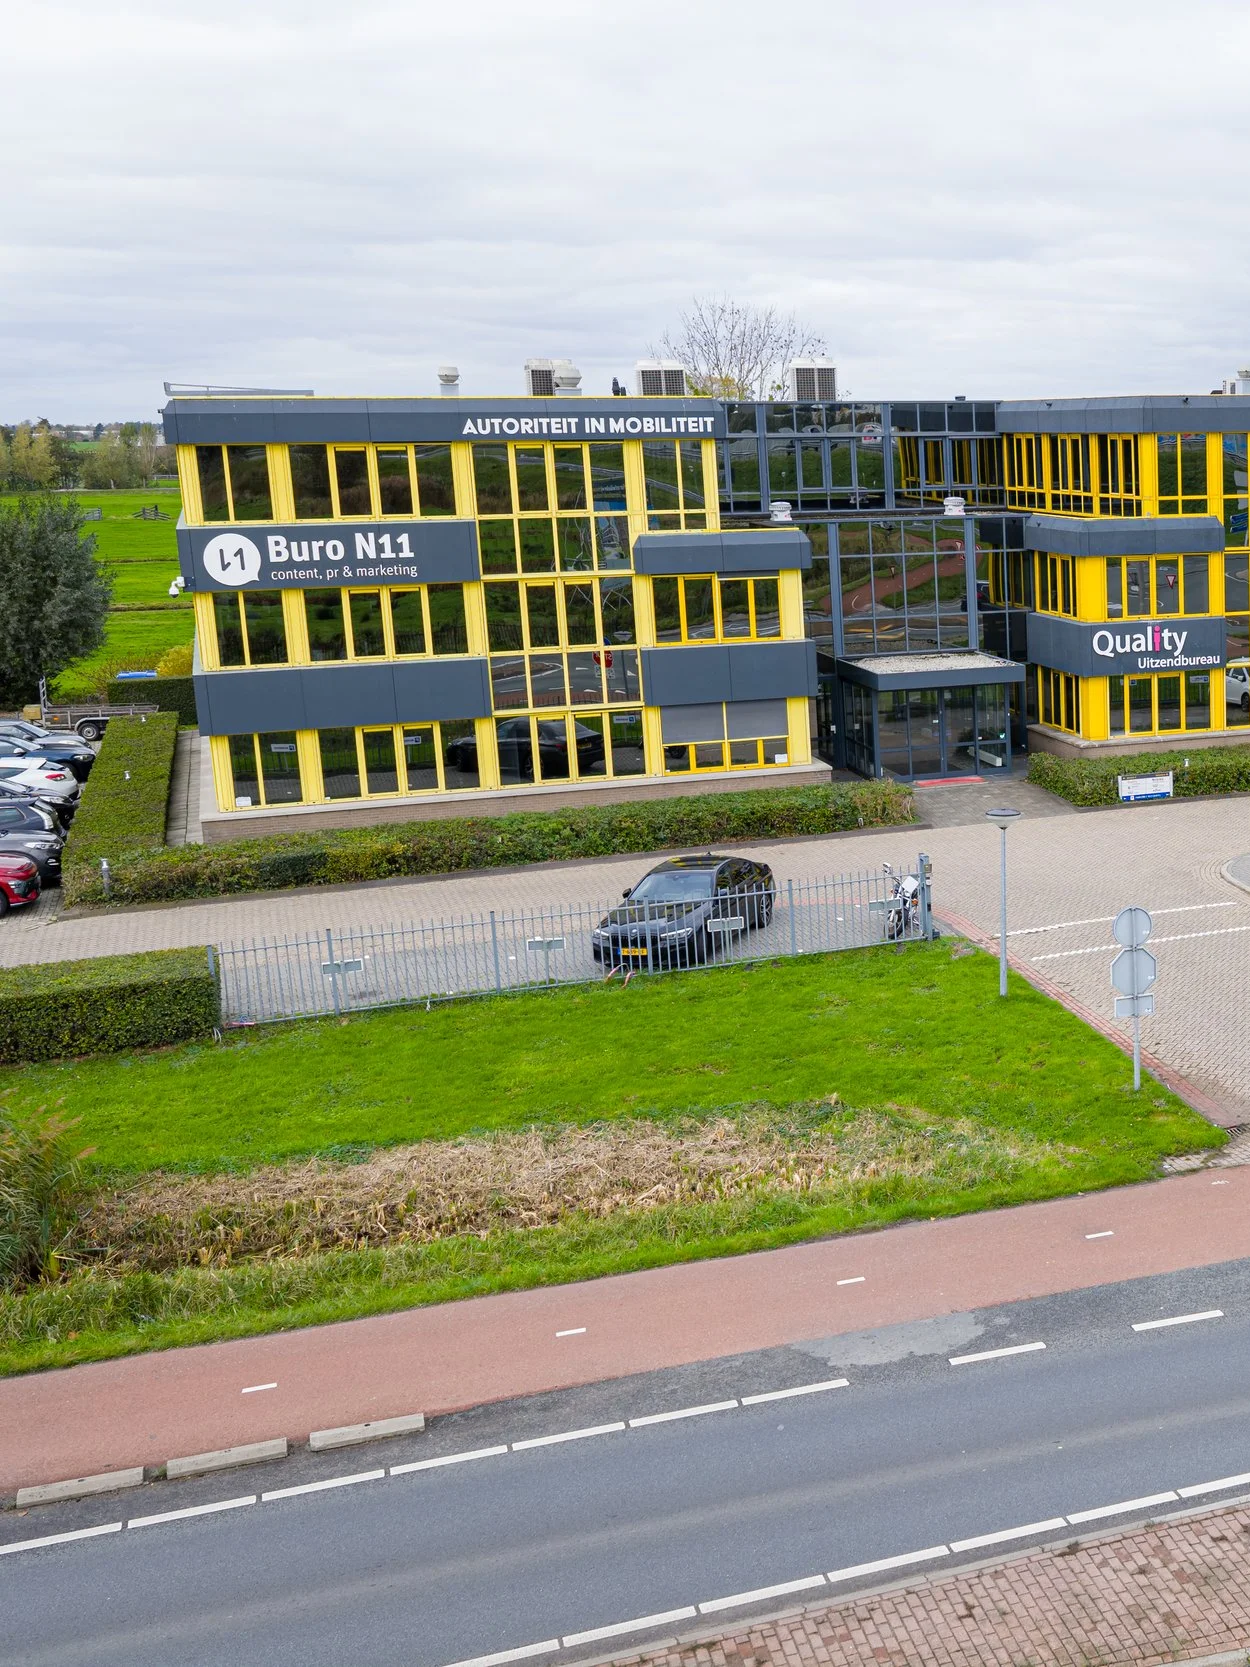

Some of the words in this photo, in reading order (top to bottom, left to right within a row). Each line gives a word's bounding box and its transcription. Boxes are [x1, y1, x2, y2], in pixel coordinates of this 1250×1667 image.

[462, 417, 578, 435] AUTORITEIT
[585, 417, 606, 434] IN
[609, 416, 715, 434] MOBILITEIT
[266, 534, 345, 563] Buro
[354, 532, 415, 560] N11
[271, 566, 323, 581] content,
[326, 566, 340, 579] pr
[343, 566, 353, 578] &
[356, 564, 418, 578] marketing
[1092, 625, 1188, 658] Quality
[1138, 655, 1221, 669] Uitzendbureau
